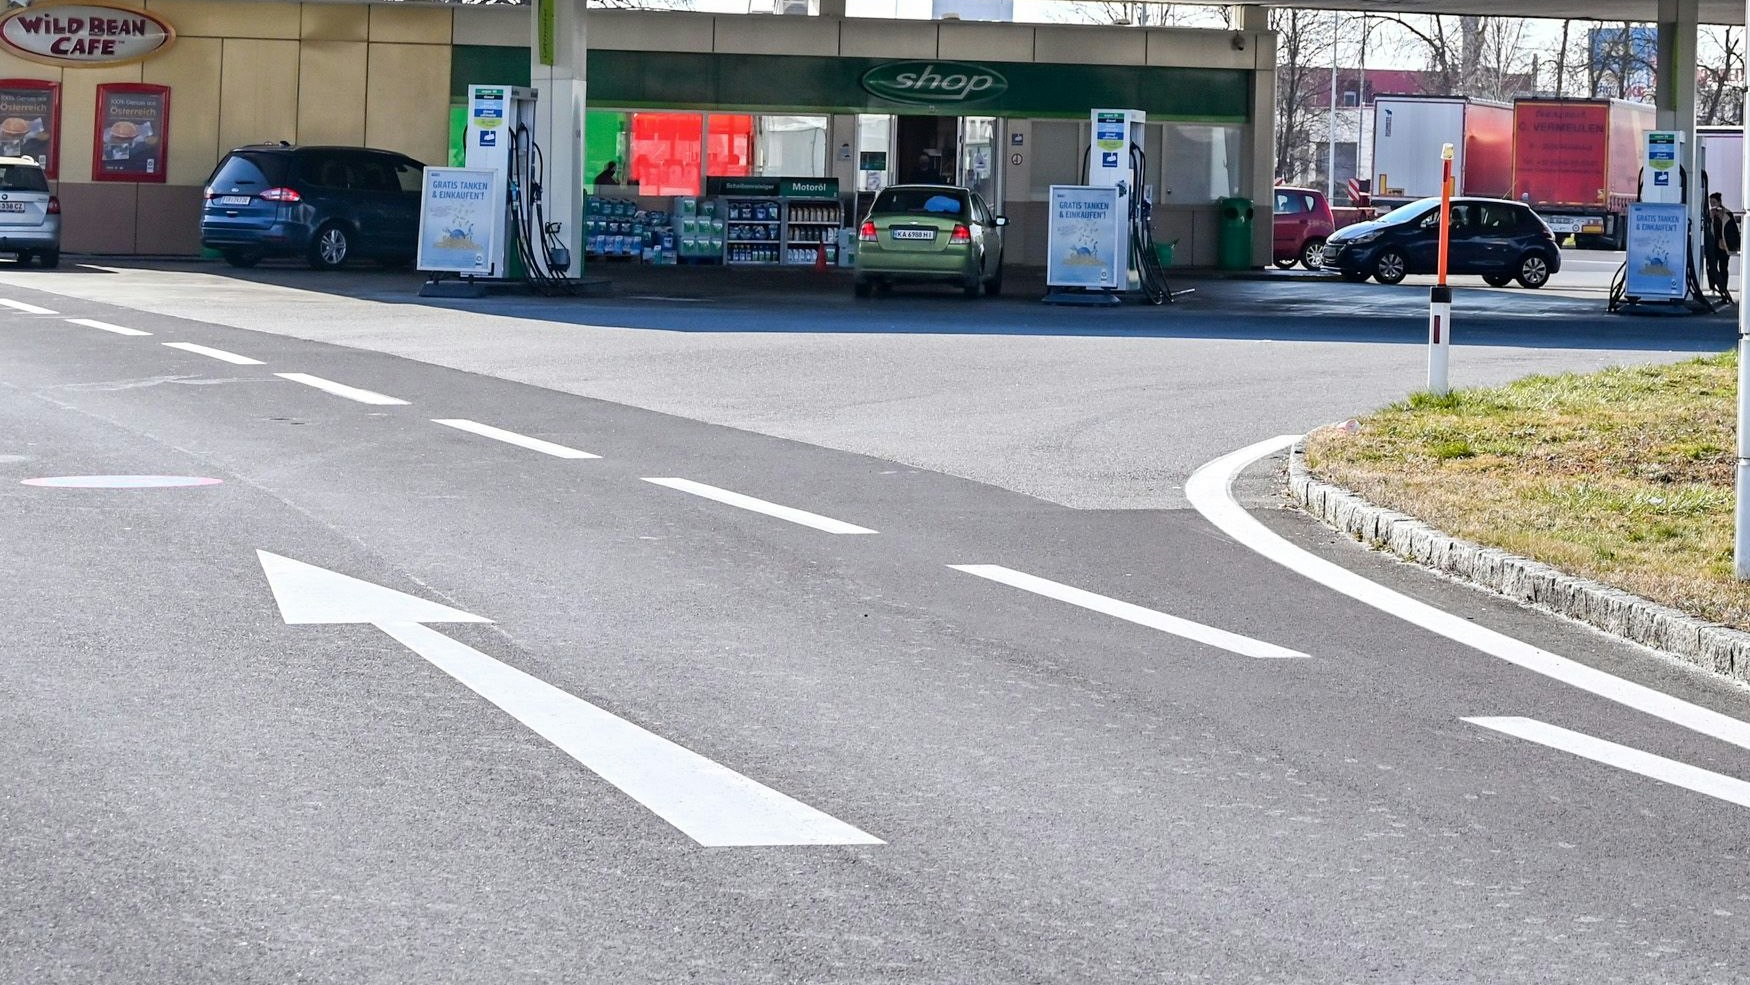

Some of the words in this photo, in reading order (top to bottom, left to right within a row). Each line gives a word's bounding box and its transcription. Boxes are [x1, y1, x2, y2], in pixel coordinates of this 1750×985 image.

[89, 16, 147, 37] BEAN
[895, 65, 993, 101] shop
[0, 99, 47, 112] Österreich
[110, 104, 157, 116] Österreich
[432, 180, 458, 190] GRATIS
[460, 181, 488, 191] TANKEN
[792, 181, 826, 192] Motoröl
[1059, 201, 1082, 210] GRATIS
[1084, 202, 1109, 211] TANKEN
[1636, 215, 1657, 223] GRATIS
[1658, 215, 1680, 224] TANKEN
